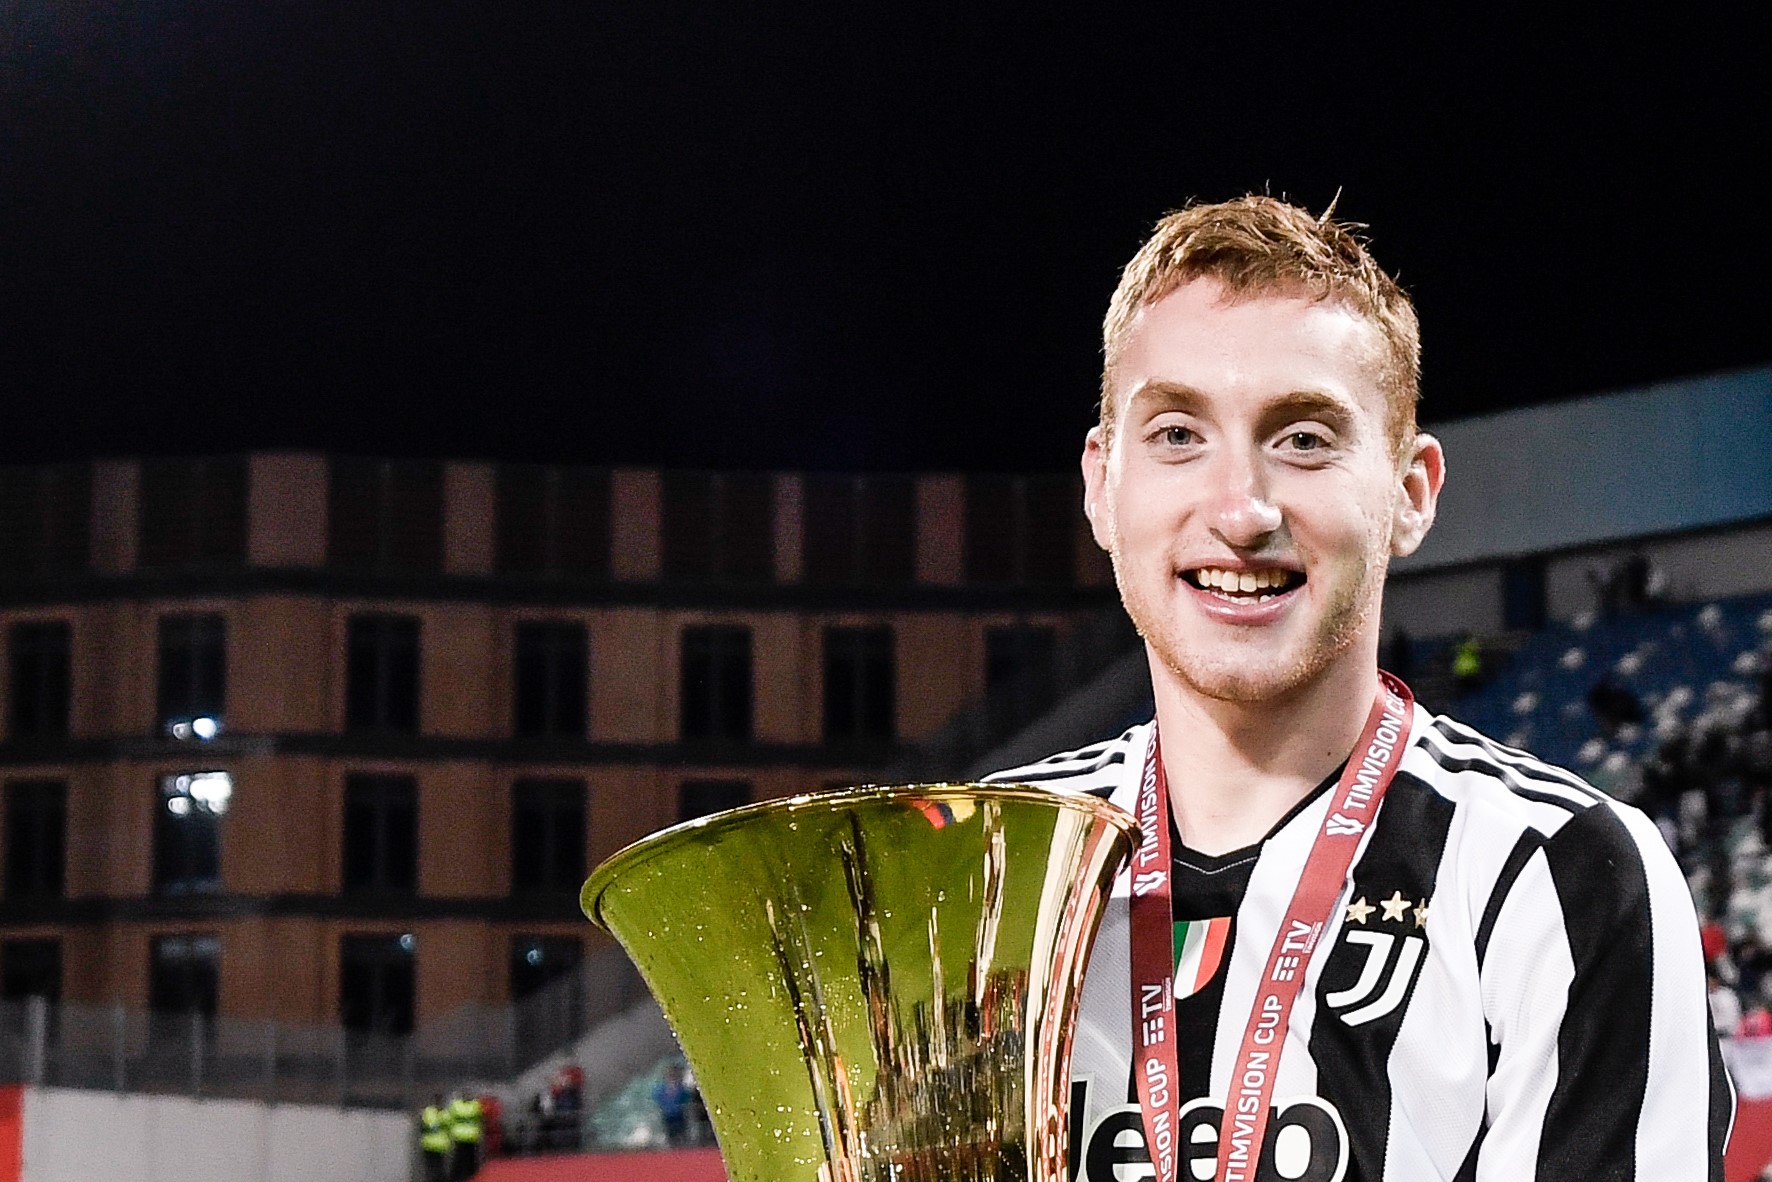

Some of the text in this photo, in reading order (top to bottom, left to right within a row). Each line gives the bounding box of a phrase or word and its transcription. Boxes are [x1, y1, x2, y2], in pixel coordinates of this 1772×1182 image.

[1343, 711, 1404, 810] TIMVISION
[1140, 757, 1160, 868] TIMVISION
[1280, 919, 1313, 954] TV
[1141, 984, 1163, 1020] TV
[1253, 994, 1283, 1045] CUP
[1145, 1057, 1169, 1109] CUP
